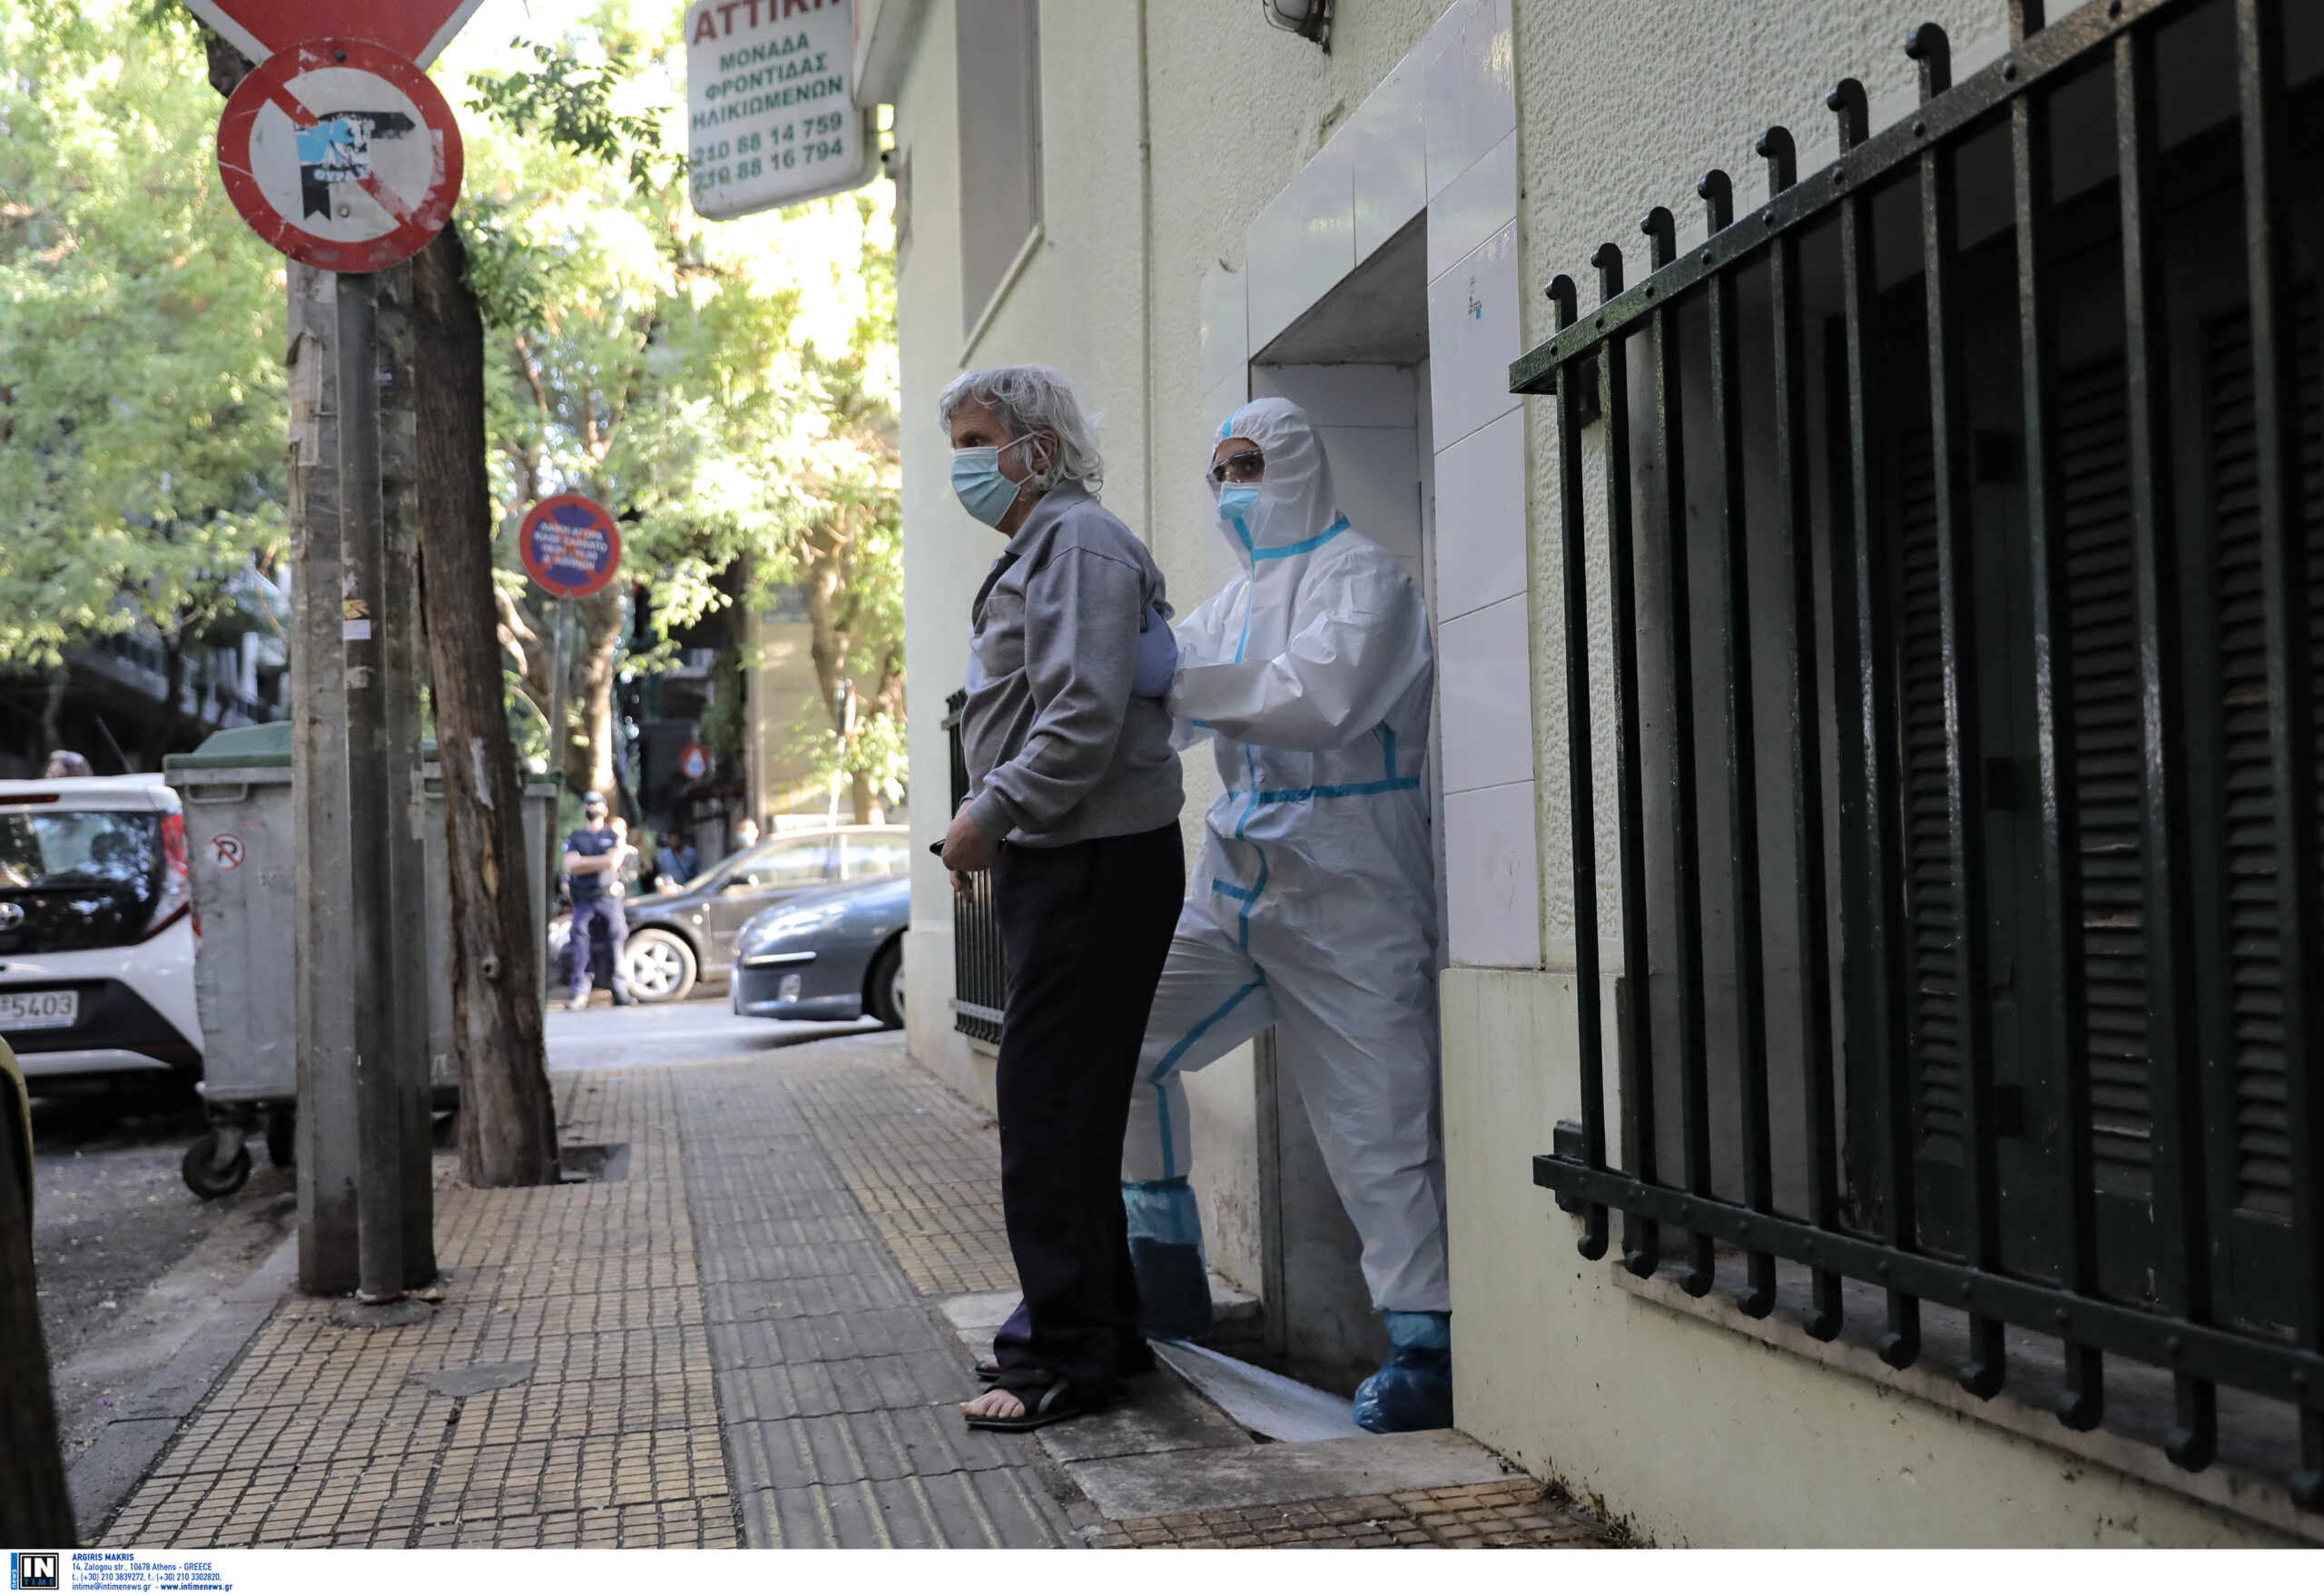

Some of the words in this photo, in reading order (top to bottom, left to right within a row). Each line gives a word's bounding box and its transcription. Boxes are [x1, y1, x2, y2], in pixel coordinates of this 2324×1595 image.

[694, 0, 840, 44] ΑΤΤΙΚ
[719, 32, 810, 72] ΜΟΝΑΔΑ
[705, 52, 828, 101] ΦΡΟΝΤΙΔΑΣ
[693, 74, 842, 130] ΗΛΙΚΙΩΜΕΝΩΝ
[694, 141, 730, 167] 210
[737, 132, 762, 154] 88
[770, 123, 794, 145] 14
[803, 111, 842, 138] 759
[737, 157, 762, 180] 88
[770, 149, 795, 172] 16
[803, 138, 842, 164] 794
